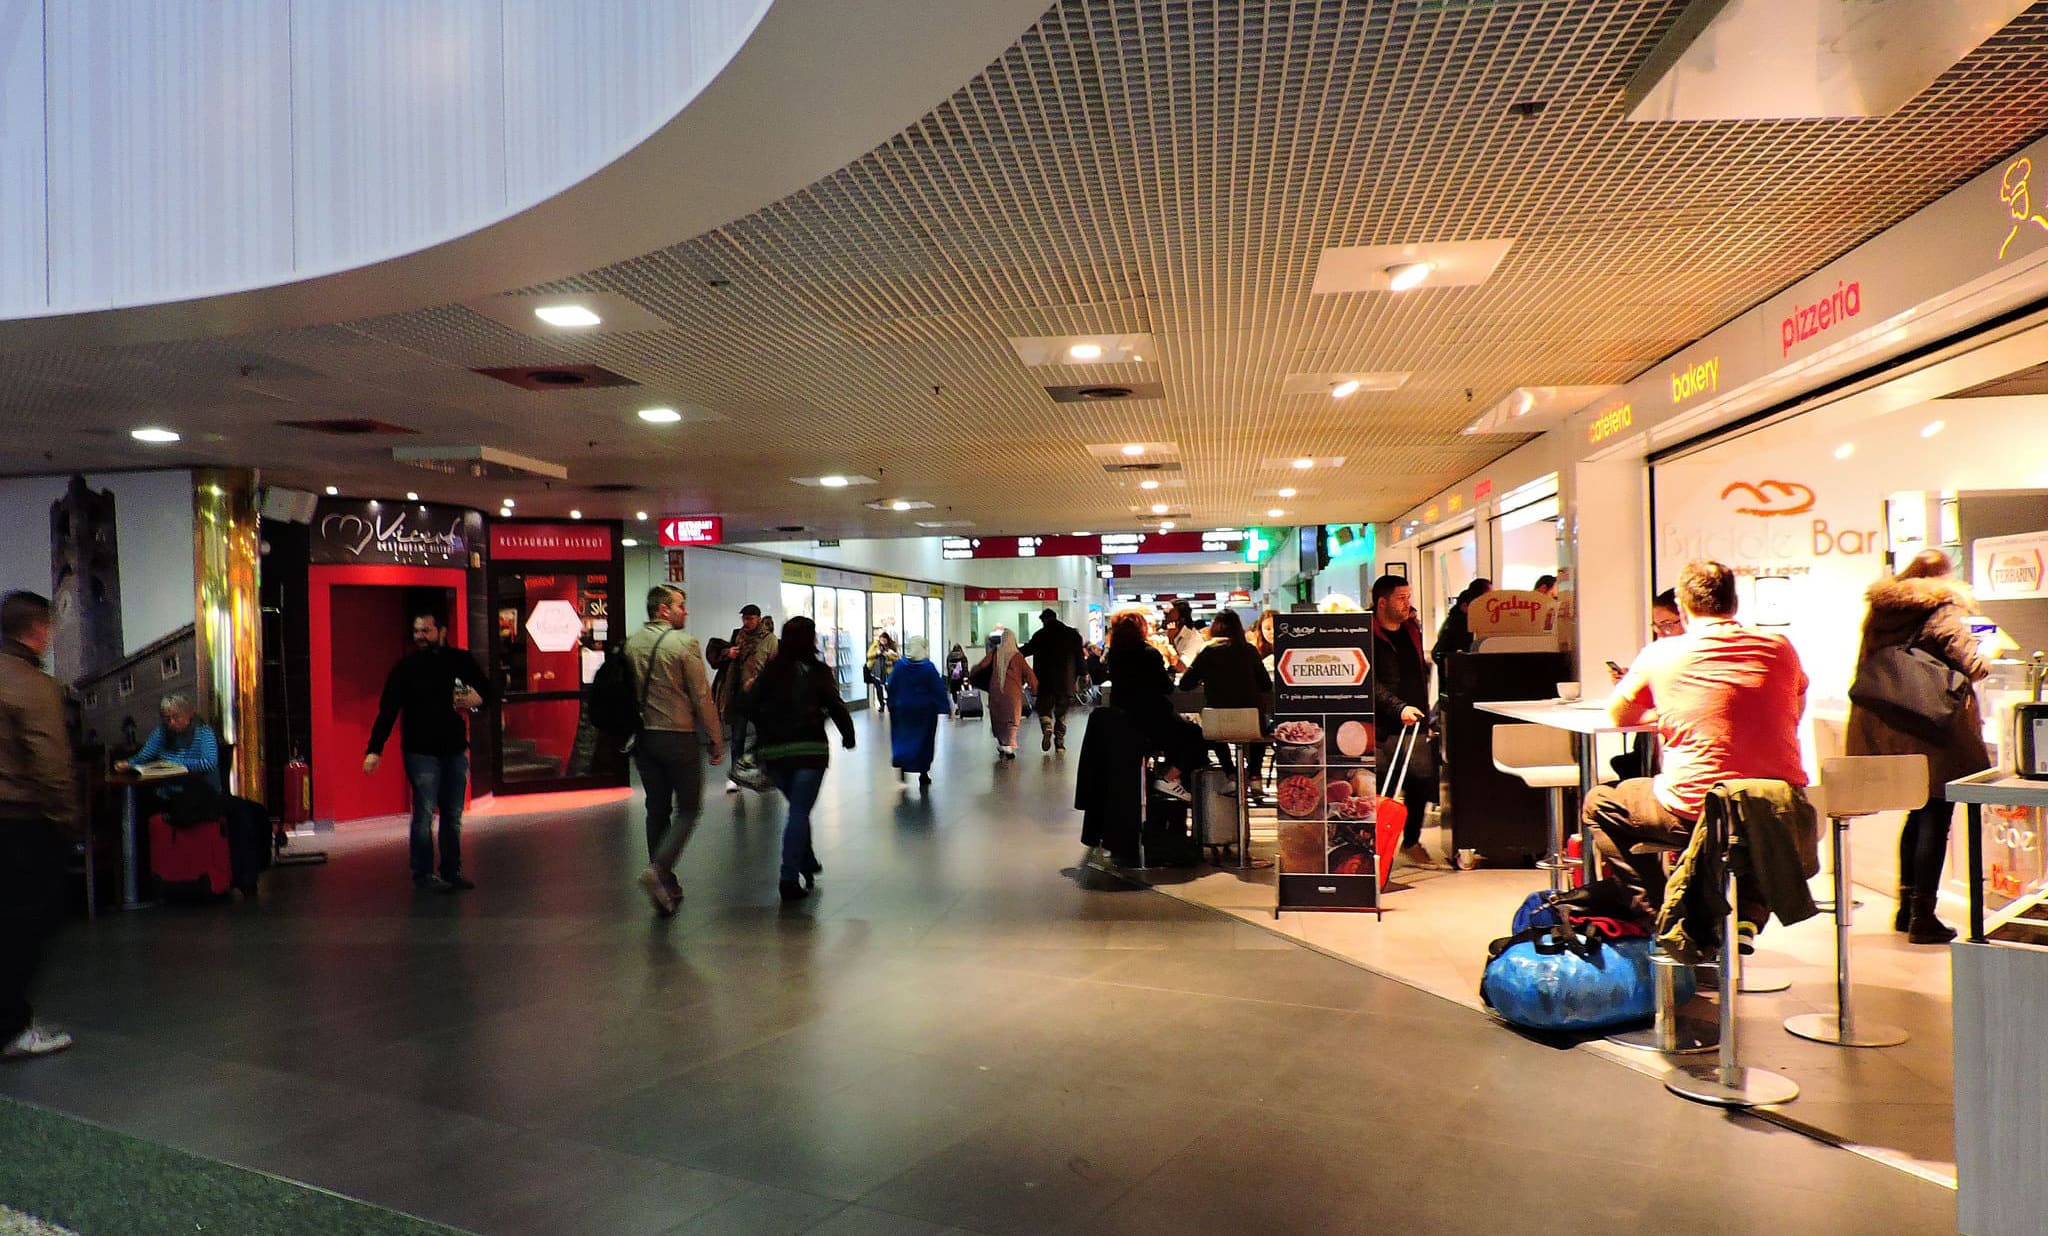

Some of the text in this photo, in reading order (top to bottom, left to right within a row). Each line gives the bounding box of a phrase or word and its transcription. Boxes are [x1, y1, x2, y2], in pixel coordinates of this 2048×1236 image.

[1782, 280, 1860, 357] pizzeria
[1671, 356, 1720, 403] bakery
[500, 536, 603, 548] RESTAURANT BISTROT
[1811, 518, 1878, 556] Bar
[1486, 595, 1542, 624] Galup
[1292, 663, 1355, 677] FERRARINI
